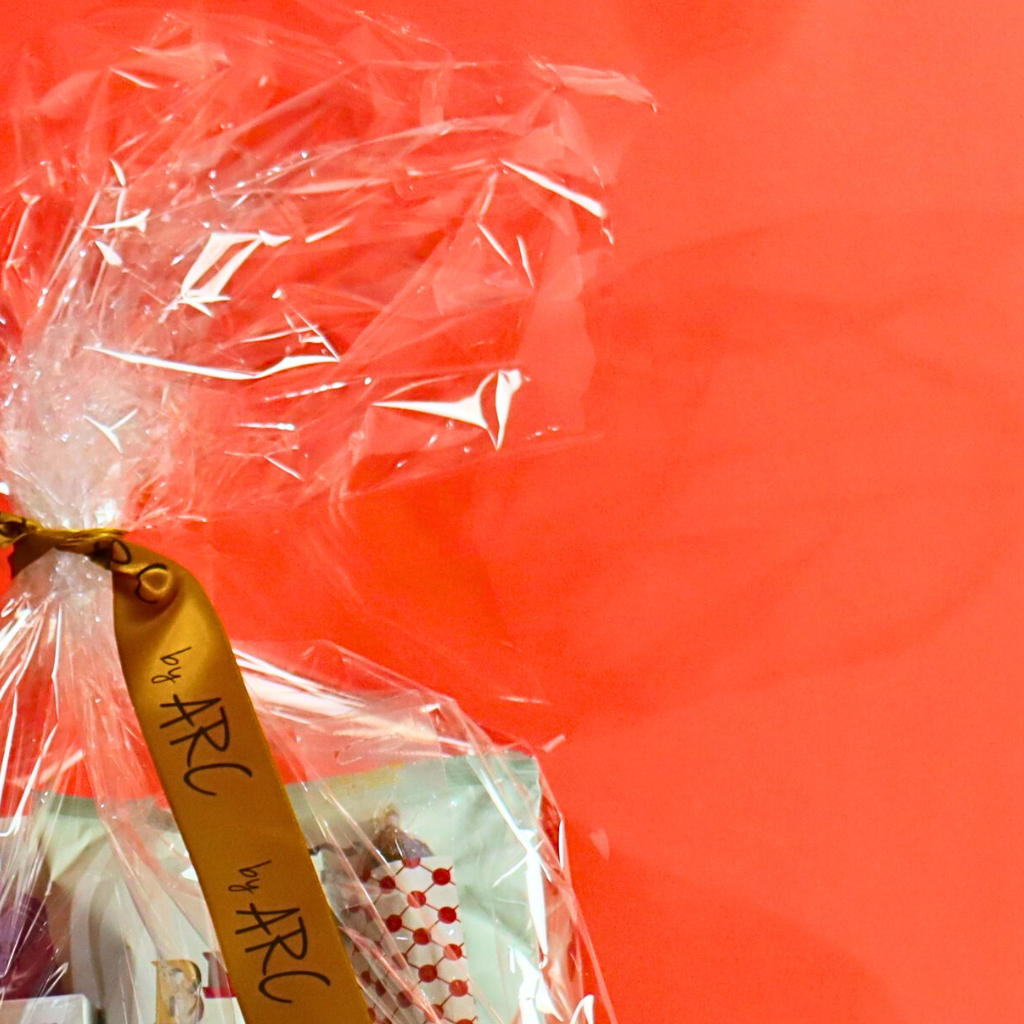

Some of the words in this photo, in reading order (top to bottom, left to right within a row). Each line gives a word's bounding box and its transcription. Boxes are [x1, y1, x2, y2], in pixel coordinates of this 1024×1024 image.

[151, 646, 192, 684] by
[160, 693, 252, 797] ARC
[228, 860, 272, 894] by
[235, 902, 331, 1004] ARC
